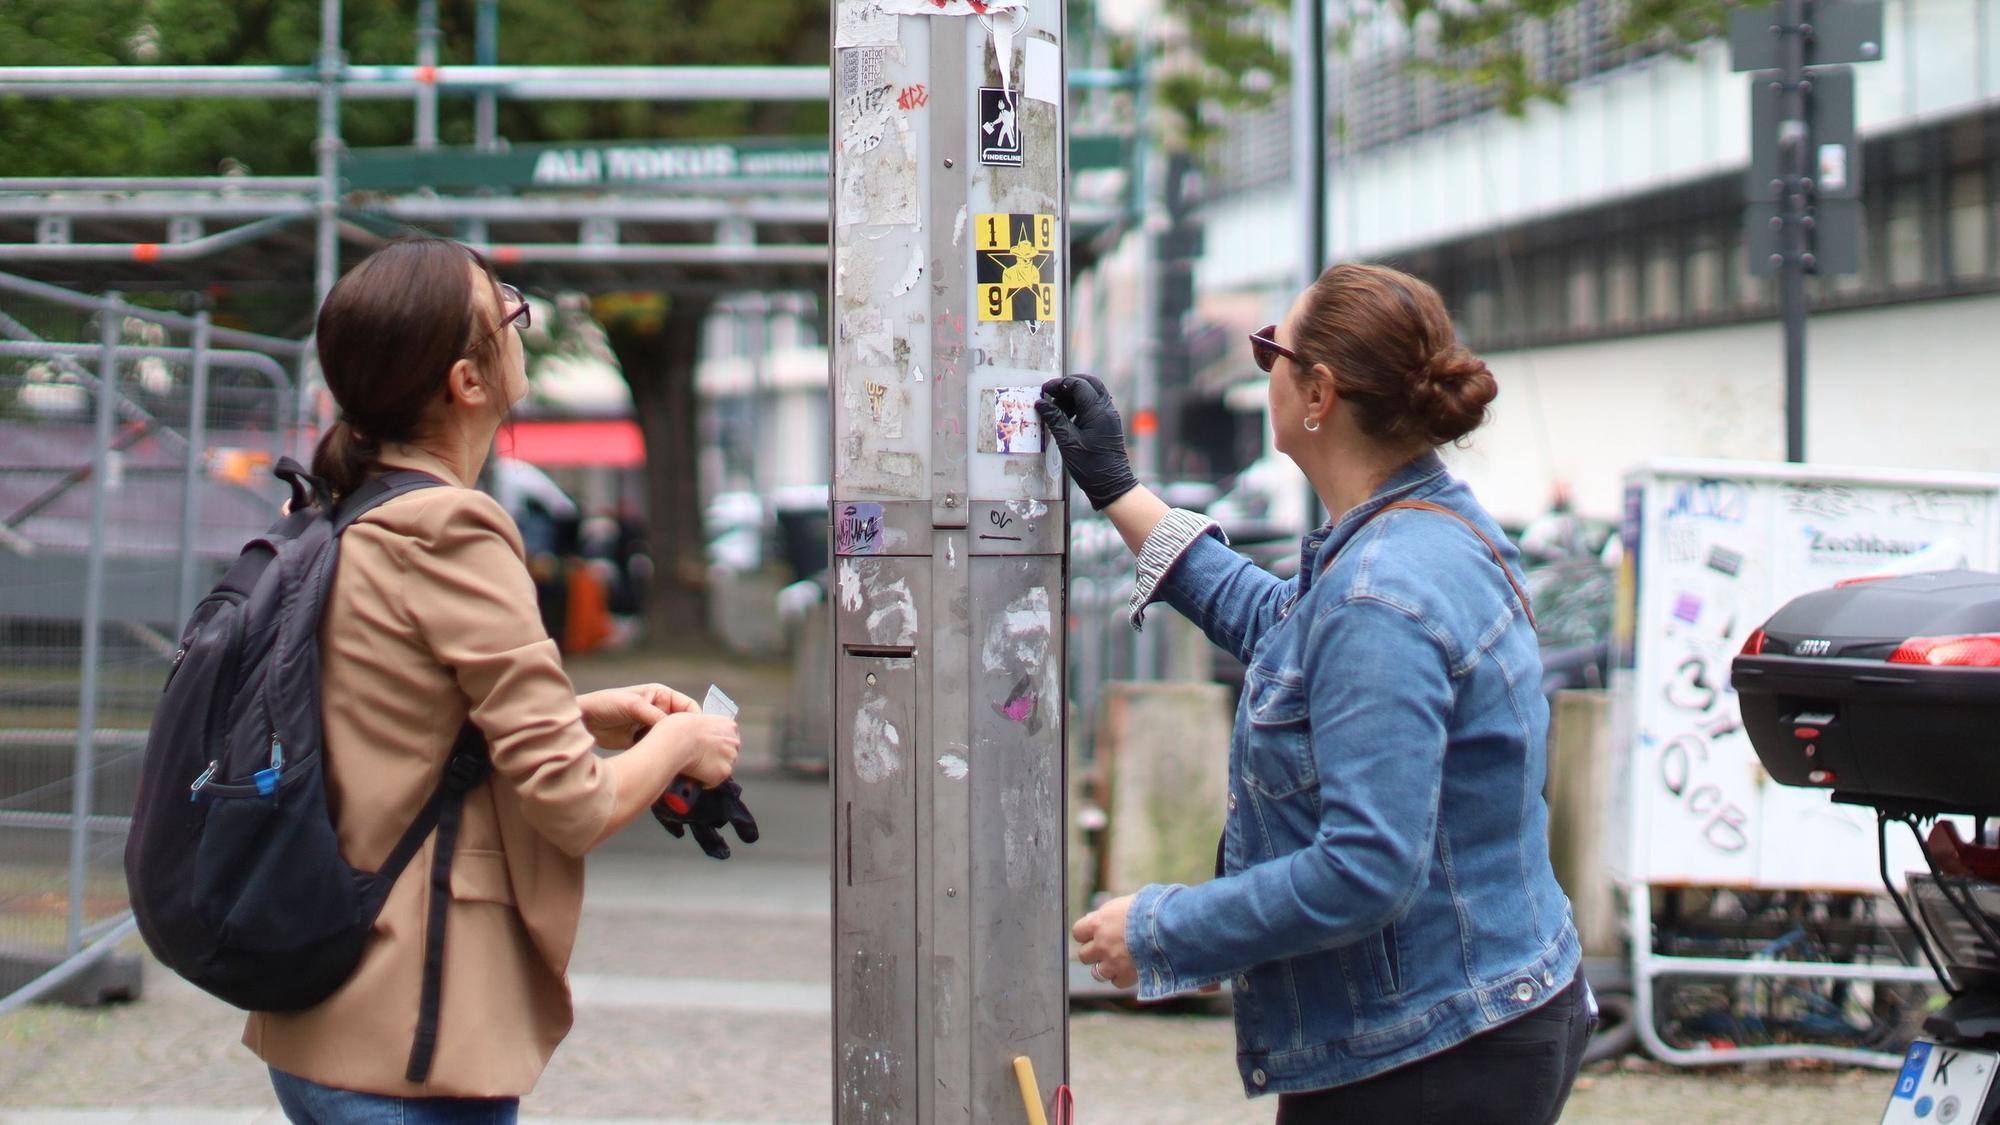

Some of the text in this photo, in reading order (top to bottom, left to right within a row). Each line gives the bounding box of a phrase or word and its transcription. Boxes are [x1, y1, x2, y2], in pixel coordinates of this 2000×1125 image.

[532, 149, 602, 186] ALI
[605, 146, 737, 179] TOKUS
[987, 154, 1022, 162] INDECLINE
[988, 217, 1050, 247] 1 9
[989, 286, 1051, 316] 9 9
[1933, 1051, 1958, 1085] K
[1902, 1077, 1914, 1092] D
